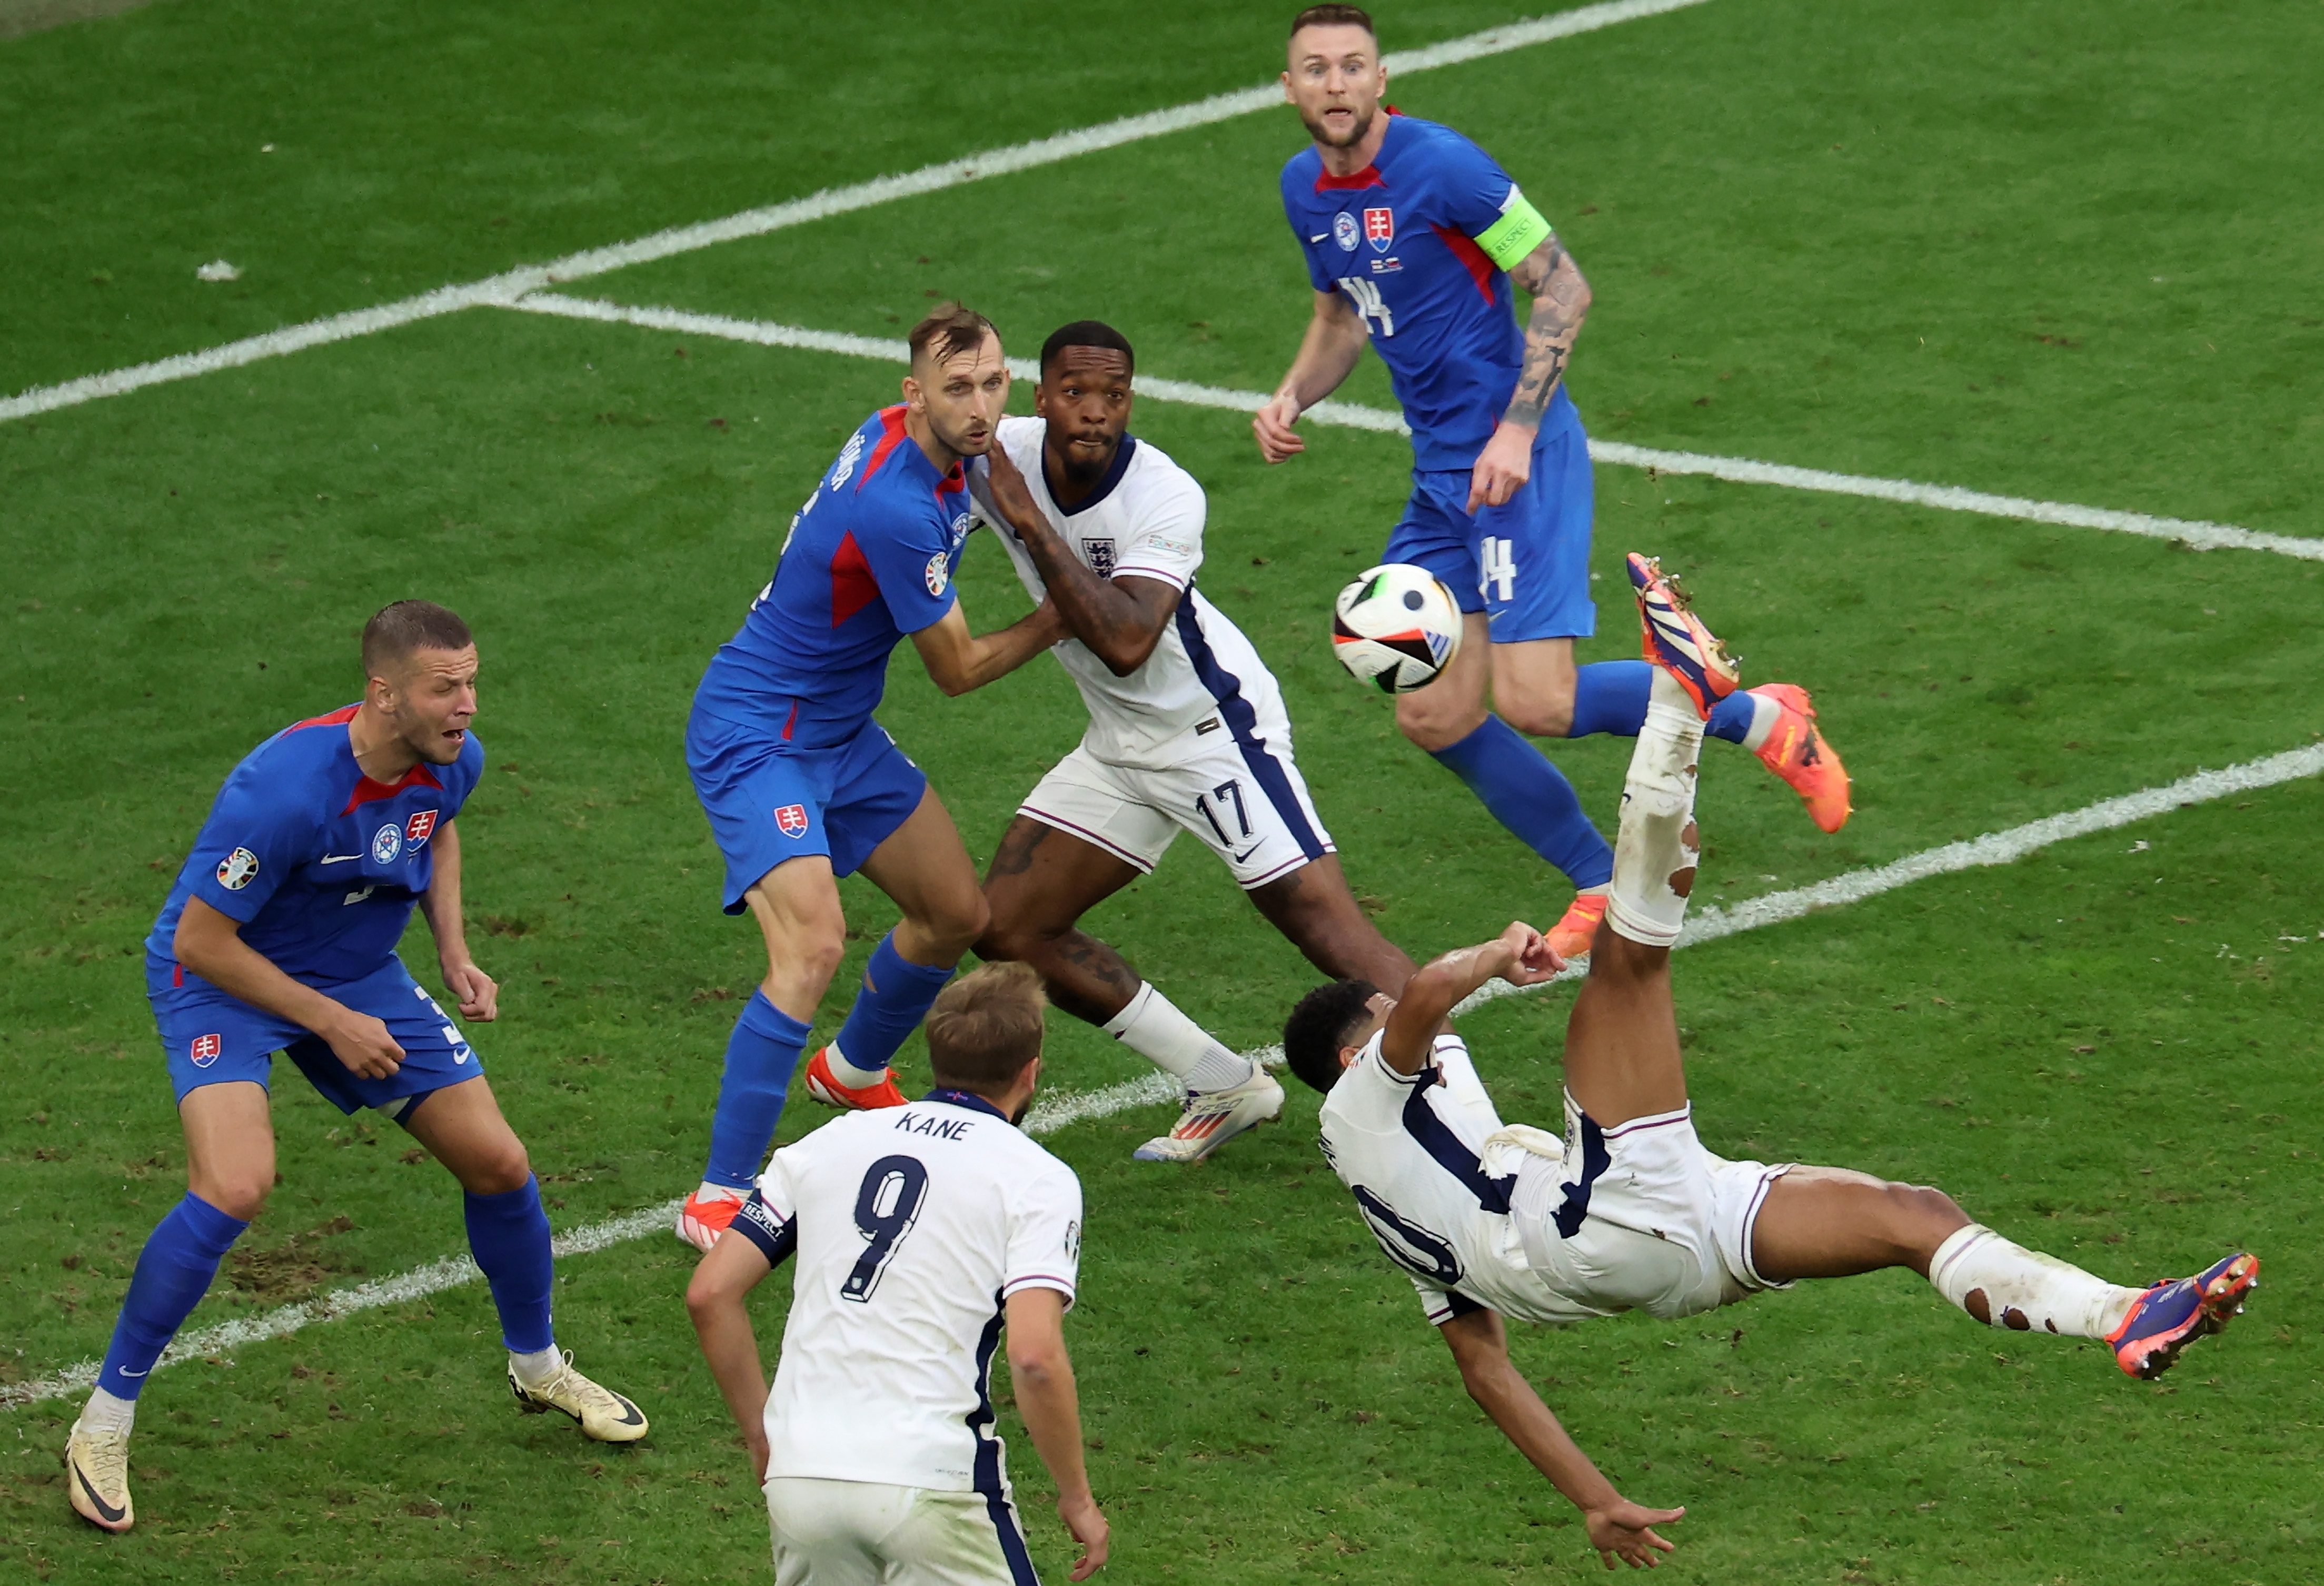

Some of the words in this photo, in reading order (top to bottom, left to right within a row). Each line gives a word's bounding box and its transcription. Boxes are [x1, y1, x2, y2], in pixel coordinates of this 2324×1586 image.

[1495, 217, 1532, 252] RESPECT
[1337, 275, 1394, 338] 14
[1478, 536, 1517, 605] 14
[1196, 778, 1254, 848] 17
[895, 1112, 976, 1141] KANE
[743, 1204, 784, 1237] RESPECT
[841, 1154, 929, 1304] 9
